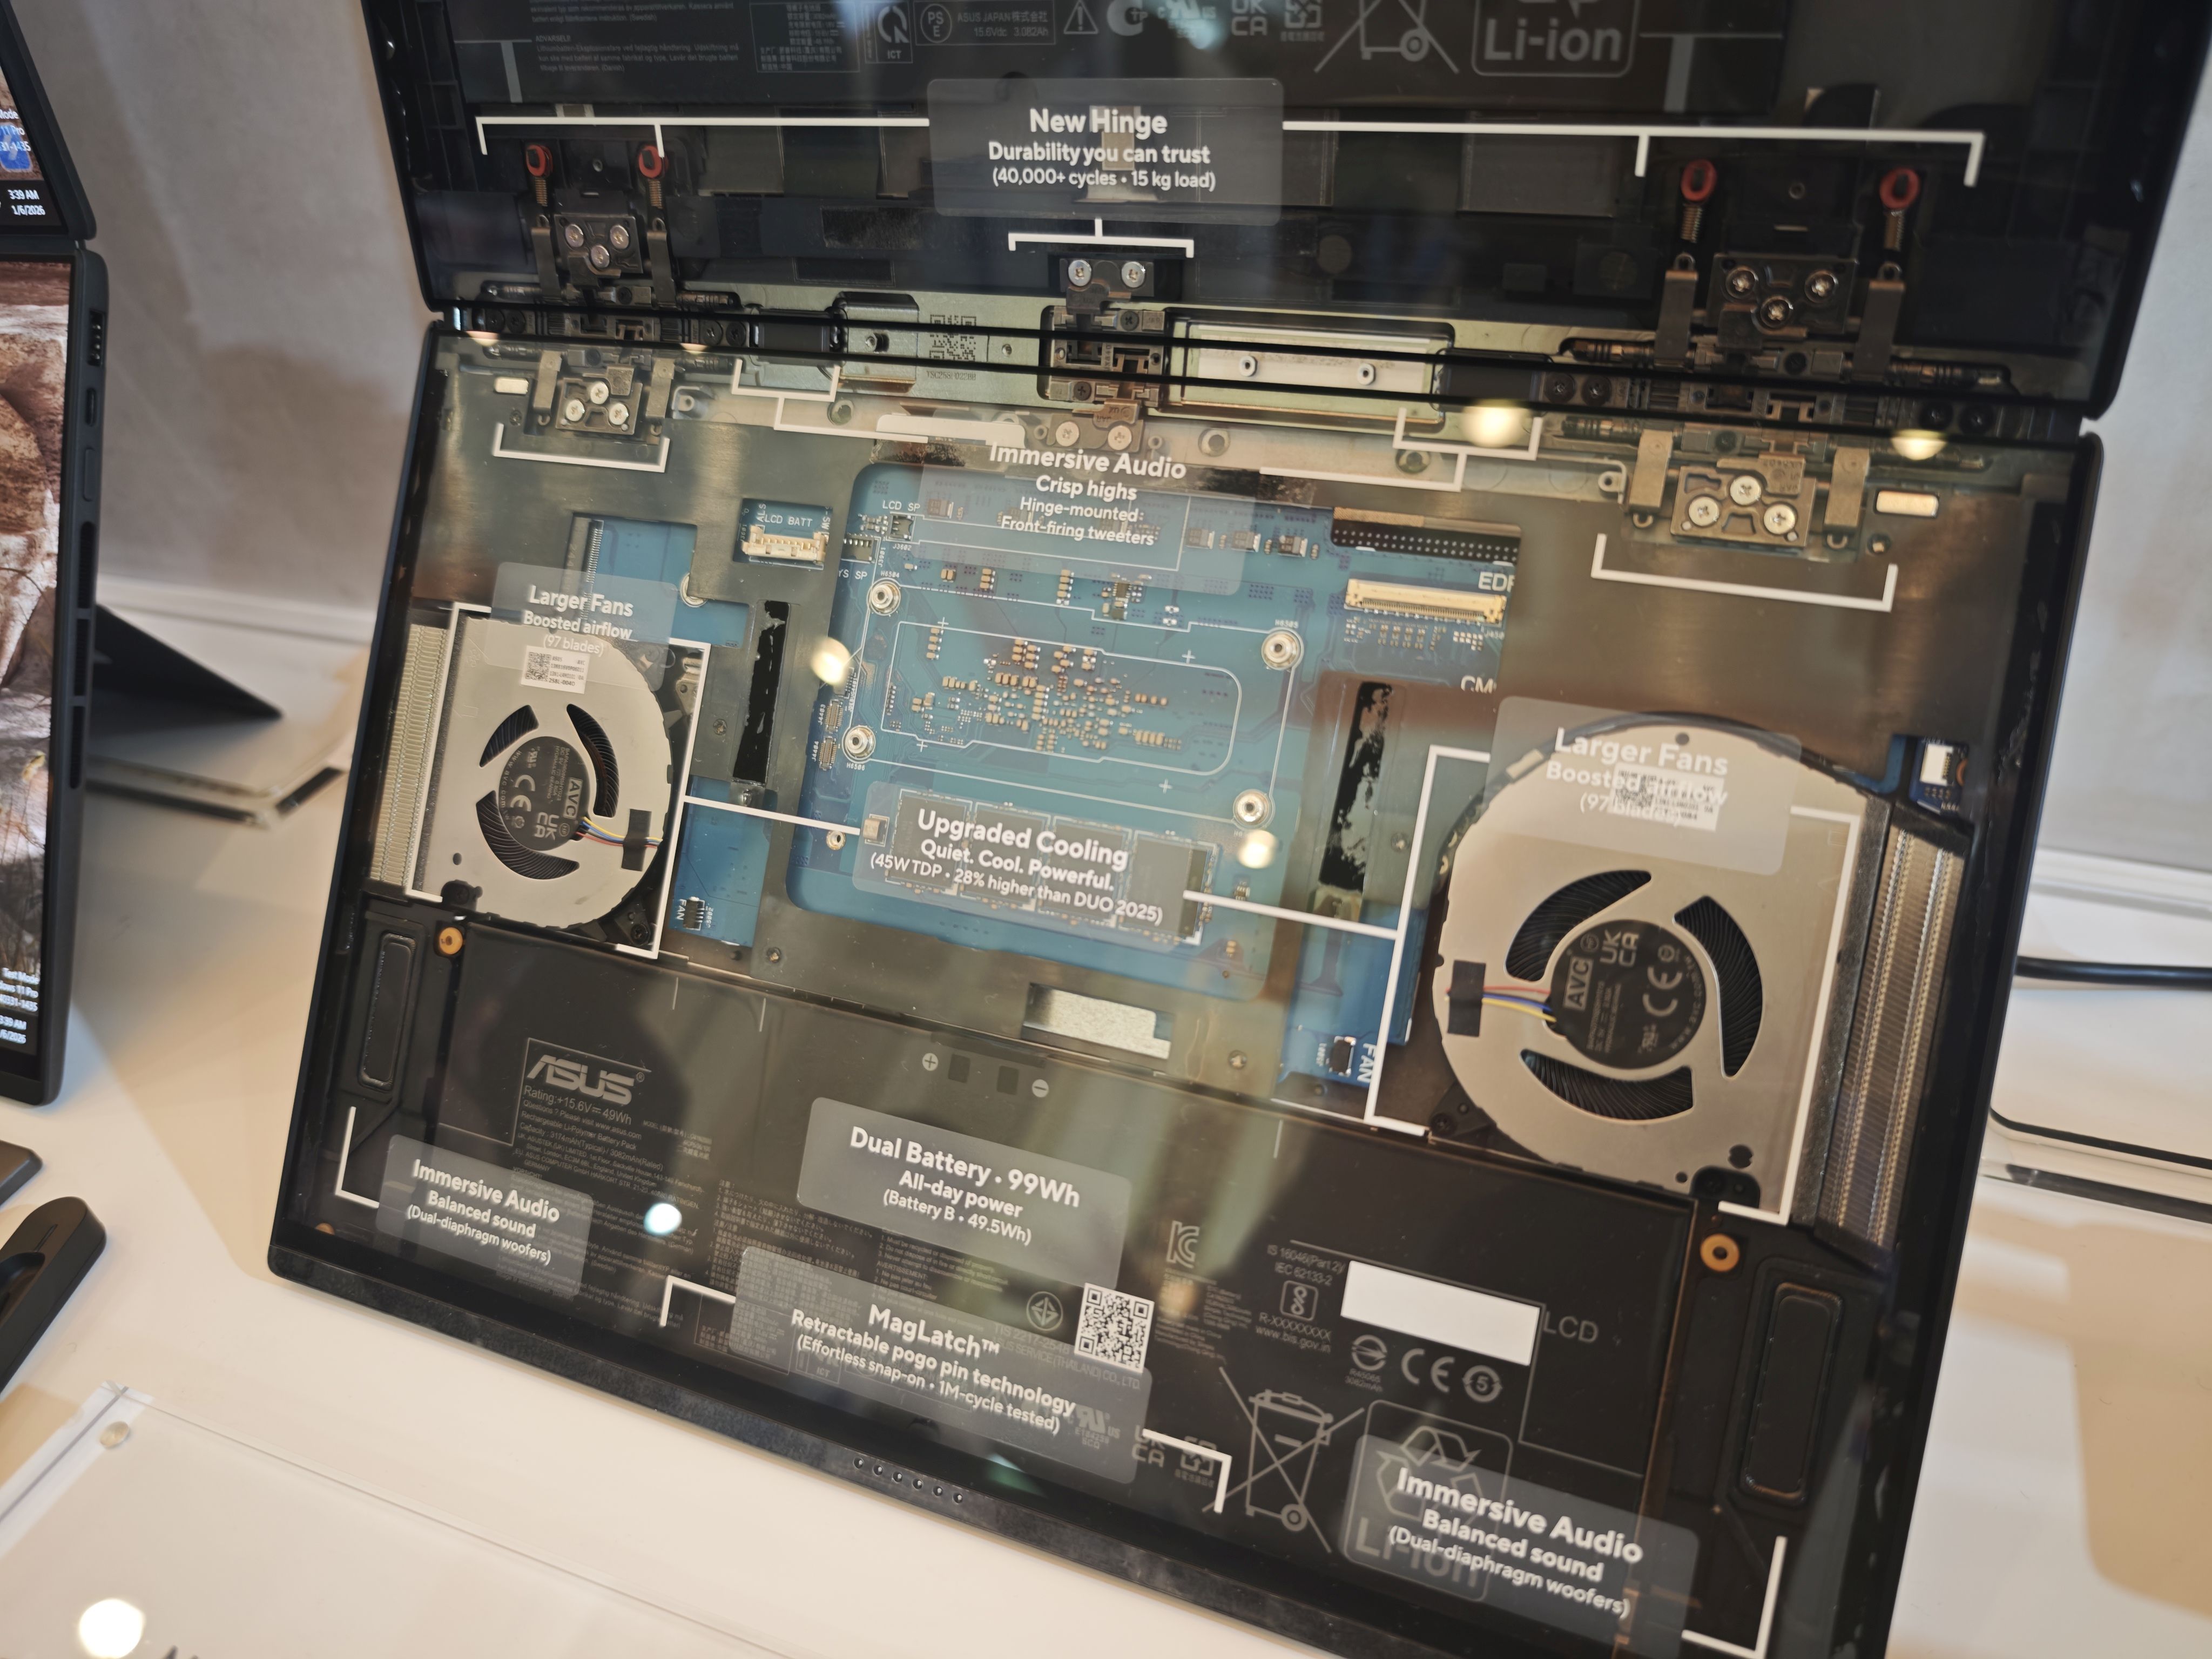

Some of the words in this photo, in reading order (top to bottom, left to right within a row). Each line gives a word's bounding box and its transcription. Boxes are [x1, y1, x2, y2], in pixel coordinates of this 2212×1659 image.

[957, 12, 980, 23] ASUS
[1231, 16, 1267, 36] CA
[887, 50, 901, 59] ICT
[1483, 17, 1622, 61] Li-ion
[1029, 107, 1087, 133] New
[1091, 108, 1168, 140] Hinge
[988, 141, 1080, 166] Durability
[1083, 147, 1119, 167] you
[1123, 149, 1157, 163] can
[1161, 145, 1211, 164] trust
[25, 189, 39, 200] AM
[993, 167, 1065, 188] (40,000+
[1069, 169, 1117, 190] cycles
[1131, 172, 1149, 186] 15
[1151, 172, 1171, 191] kg
[1174, 172, 1216, 192] load)
[989, 442, 1111, 473] Immersive
[1112, 452, 1187, 480] Audio
[882, 499, 903, 511] LCD
[907, 502, 921, 512] SP
[1035, 474, 1084, 497] Crisp
[1087, 478, 1138, 502] highs
[757, 503, 767, 523] ALS
[765, 514, 783, 524] LCD
[788, 517, 813, 528] BATT
[1001, 515, 1085, 542] Front-firing
[1088, 525, 1156, 546] tweeters
[855, 570, 868, 580] SP
[528, 584, 589, 612] Larger
[590, 593, 634, 617] Fans
[523, 610, 581, 633] Boosted
[583, 620, 633, 640] airflow
[543, 634, 561, 649] (97
[563, 636, 604, 657] blades)
[1554, 727, 1651, 766] Larger
[1658, 743, 1729, 776] Fans
[566, 780, 581, 817] AVC
[1546, 760, 1641, 793] Boosted
[1647, 775, 1728, 806] airflow
[1580, 792, 1609, 814] (97
[534, 812, 548, 838] CA
[545, 814, 559, 840] UK
[917, 807, 1031, 849] Upgraded
[1035, 832, 1129, 872] Cooling
[920, 841, 974, 865] Quiet.
[978, 849, 1024, 874] Cool.
[1028, 859, 1115, 892] Powerful.
[870, 851, 911, 873] (45W
[912, 859, 942, 878] TDP
[954, 868, 986, 888] 28%
[987, 874, 1036, 900] higher
[1037, 884, 1071, 905] than
[1074, 894, 1114, 914] DUO
[1116, 901, 1163, 926] 2025)
[676, 898, 687, 921] FAN
[1600, 929, 1621, 964] UK
[1618, 932, 1640, 968] CA
[1567, 959, 1589, 1008] AVC
[1357, 1042, 1377, 1083] FAN
[526, 1054, 635, 1107] ASUS
[520, 1122, 547, 1137] Capacity
[521, 1110, 563, 1129] Rechargeable
[563, 1123, 596, 1139] Li-Polymer
[597, 1132, 621, 1148] Battery
[621, 1139, 637, 1151] Pack
[559, 1109, 581, 1122] Please
[595, 1121, 642, 1141] www.asus.com
[602, 1109, 633, 1125] 49Wh
[849, 1126, 902, 1159] Dual
[905, 1140, 992, 1185] Battery
[1007, 1168, 1081, 1208] 99Wh
[413, 1158, 504, 1204] Immersive
[504, 1189, 561, 1222] Audio
[899, 1170, 964, 1205] All-day
[965, 1186, 1024, 1218] power
[428, 1190, 491, 1223] Balanced
[493, 1213, 537, 1238] sound
[883, 1189, 943, 1220] (Battery
[943, 1205, 956, 1221] B
[967, 1212, 1033, 1246] 49.5Wh)
[407, 1204, 500, 1247] (Dual-diaphragm
[501, 1238, 551, 1266] woofers)
[867, 1303, 1001, 1360] MagLatch™
[1543, 1310, 1599, 1345] LCD
[791, 1309, 890, 1356] Retractable
[892, 1344, 938, 1371] pogo
[940, 1358, 969, 1382] pin
[973, 1367, 1078, 1419] technology
[817, 1367, 831, 1378] ICT
[1015, 1344, 1053, 1364] SERVICE
[1053, 1354, 1102, 1381] (THAILAND)
[1400, 1347, 1456, 1394] CE
[797, 1333, 868, 1370] (Effortless
[868, 1356, 926, 1389] snap-on
[939, 1379, 1003, 1418] 1M-cycle
[1006, 1397, 1061, 1436] tested)
[1131, 1442, 1165, 1468] CA
[1396, 1466, 1548, 1535] Immersive
[1549, 1515, 1644, 1564] Audio
[1421, 1507, 1528, 1560] Balanced
[1529, 1545, 1606, 1583] sound
[1388, 1524, 1545, 1591] (Dual-diaphragm
[1545, 1576, 1631, 1620] woofers)
